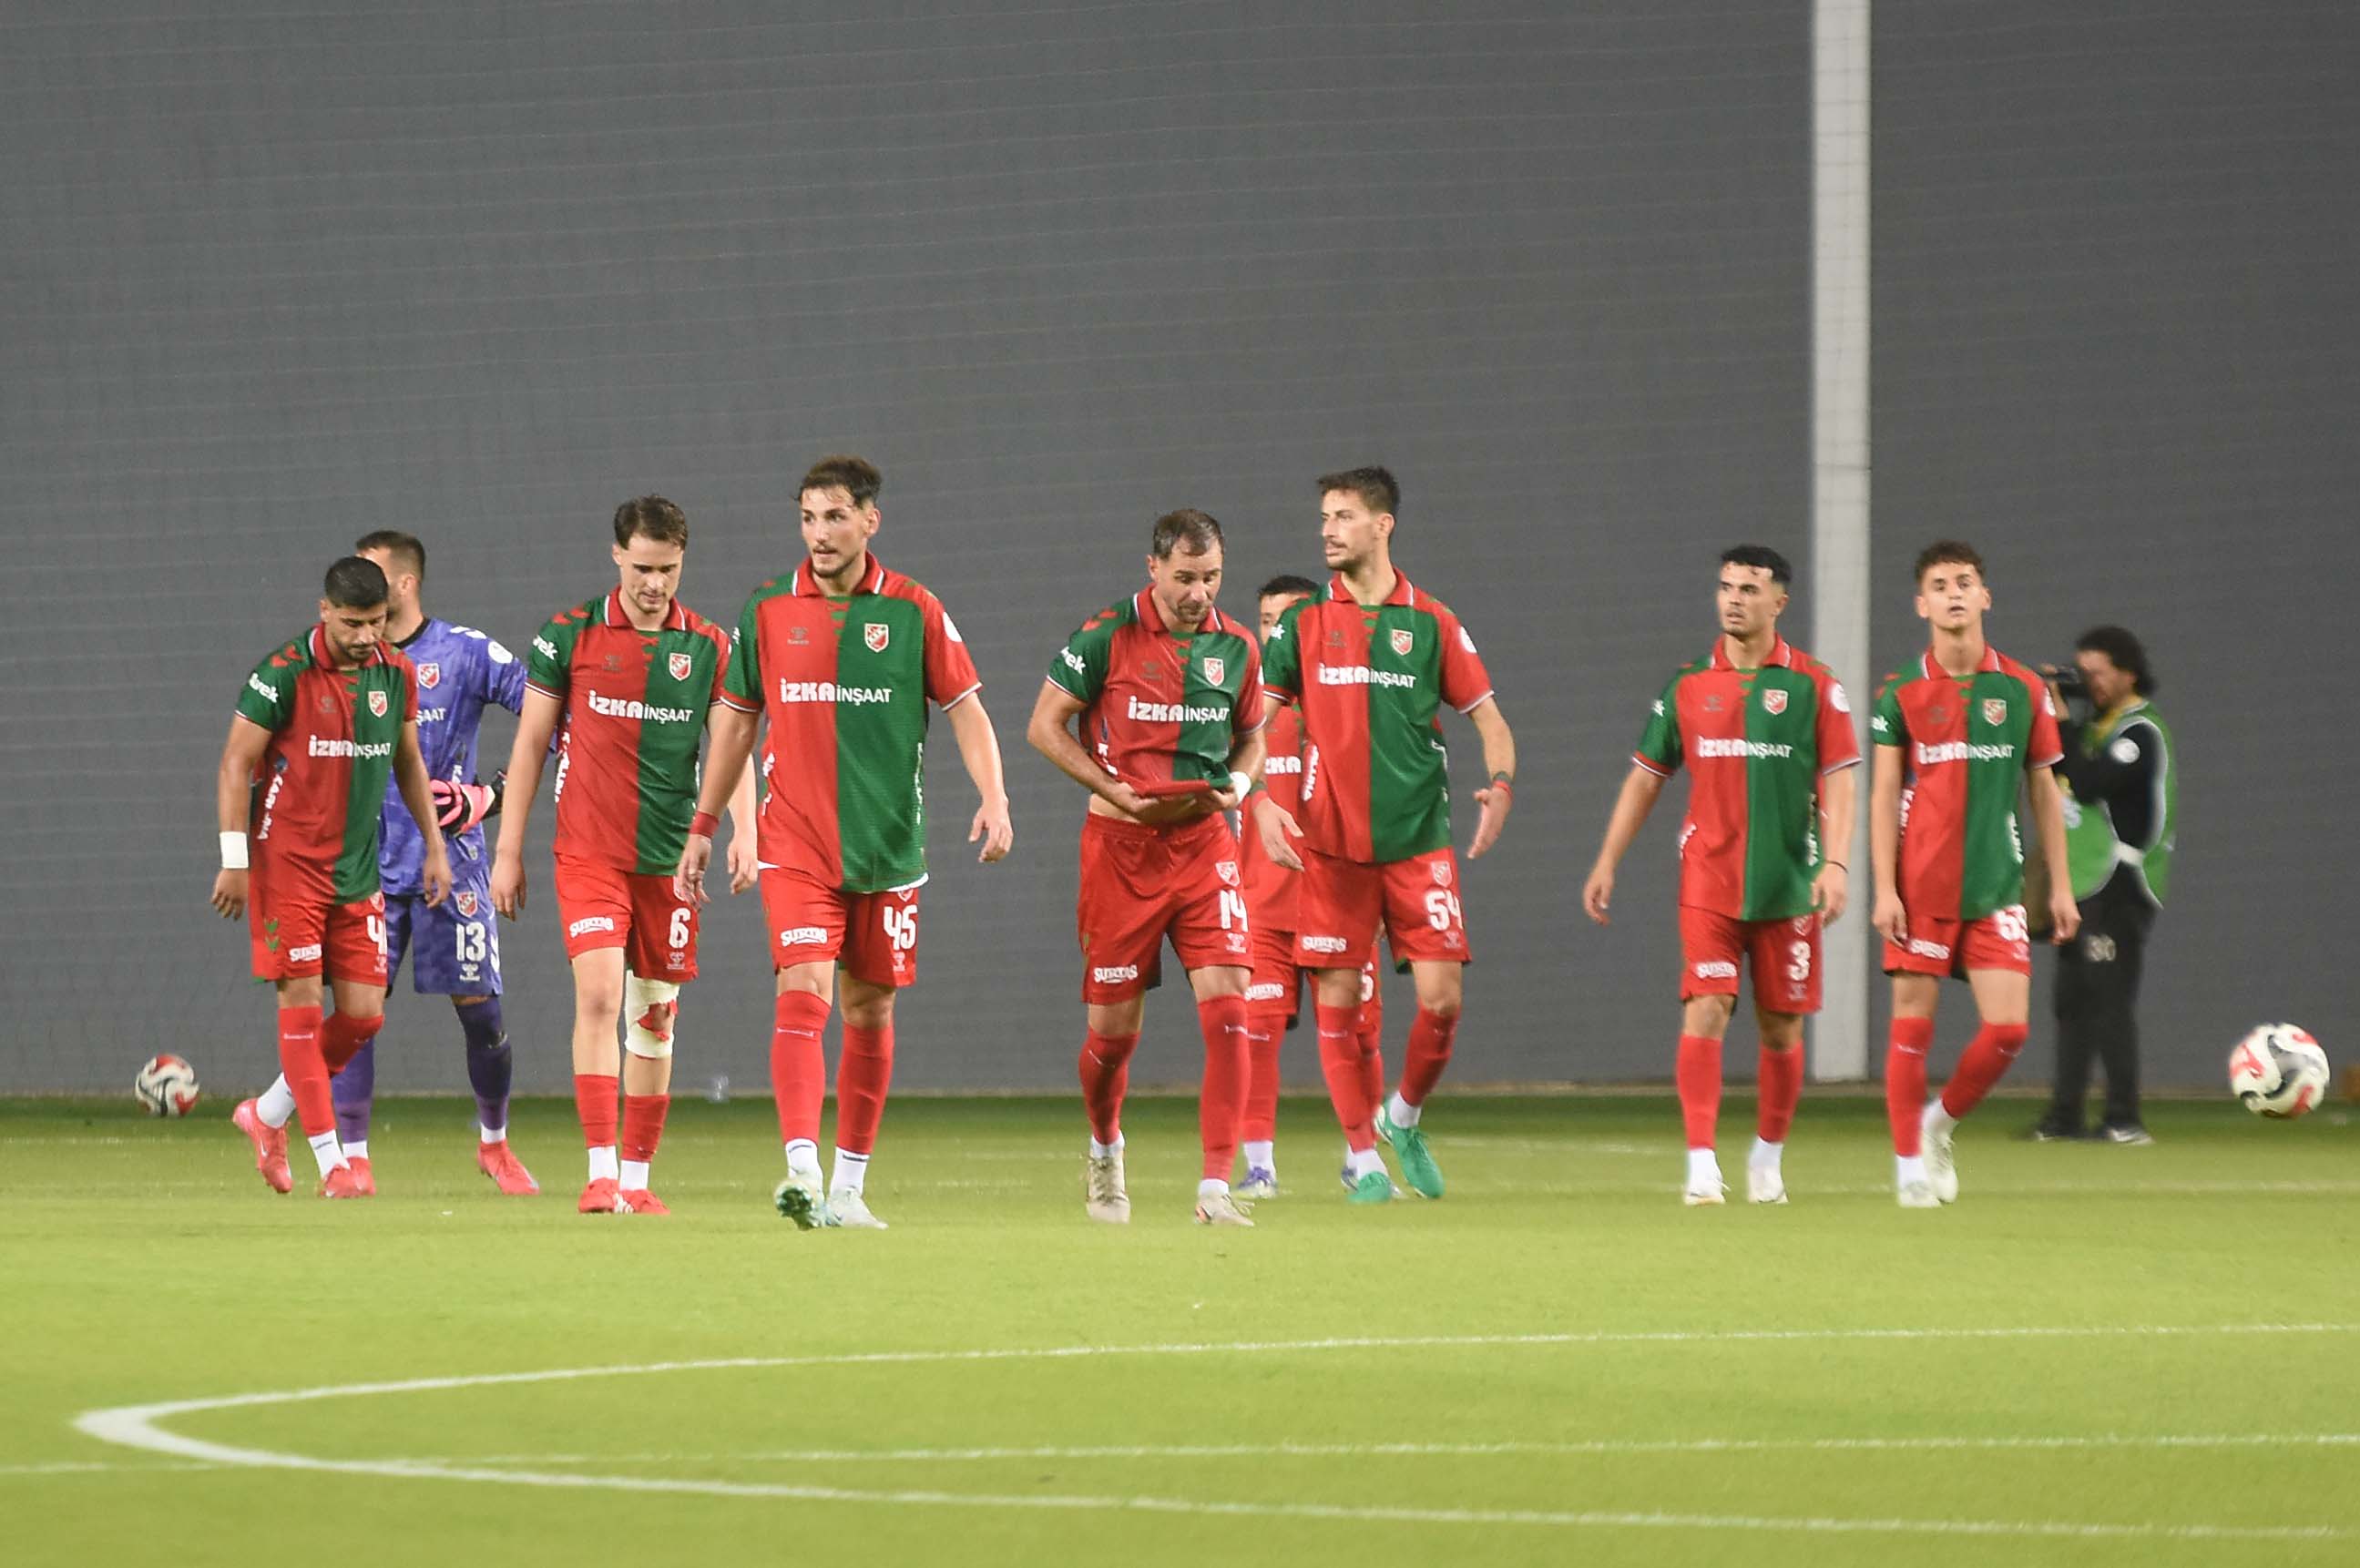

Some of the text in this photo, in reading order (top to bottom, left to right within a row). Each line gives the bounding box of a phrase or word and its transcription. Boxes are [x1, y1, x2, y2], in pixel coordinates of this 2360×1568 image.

[587, 689, 693, 725] İZKA İNŞAAT
[780, 677, 893, 706] İZKA İNŞAAT
[1128, 696, 1230, 725] İZKA İNŞAAT
[668, 907, 691, 949] 6
[883, 904, 918, 951] 45
[1219, 889, 1249, 933] 14
[1425, 889, 1464, 932] 54
[456, 921, 485, 962] 13
[1788, 941, 1811, 981] 3
